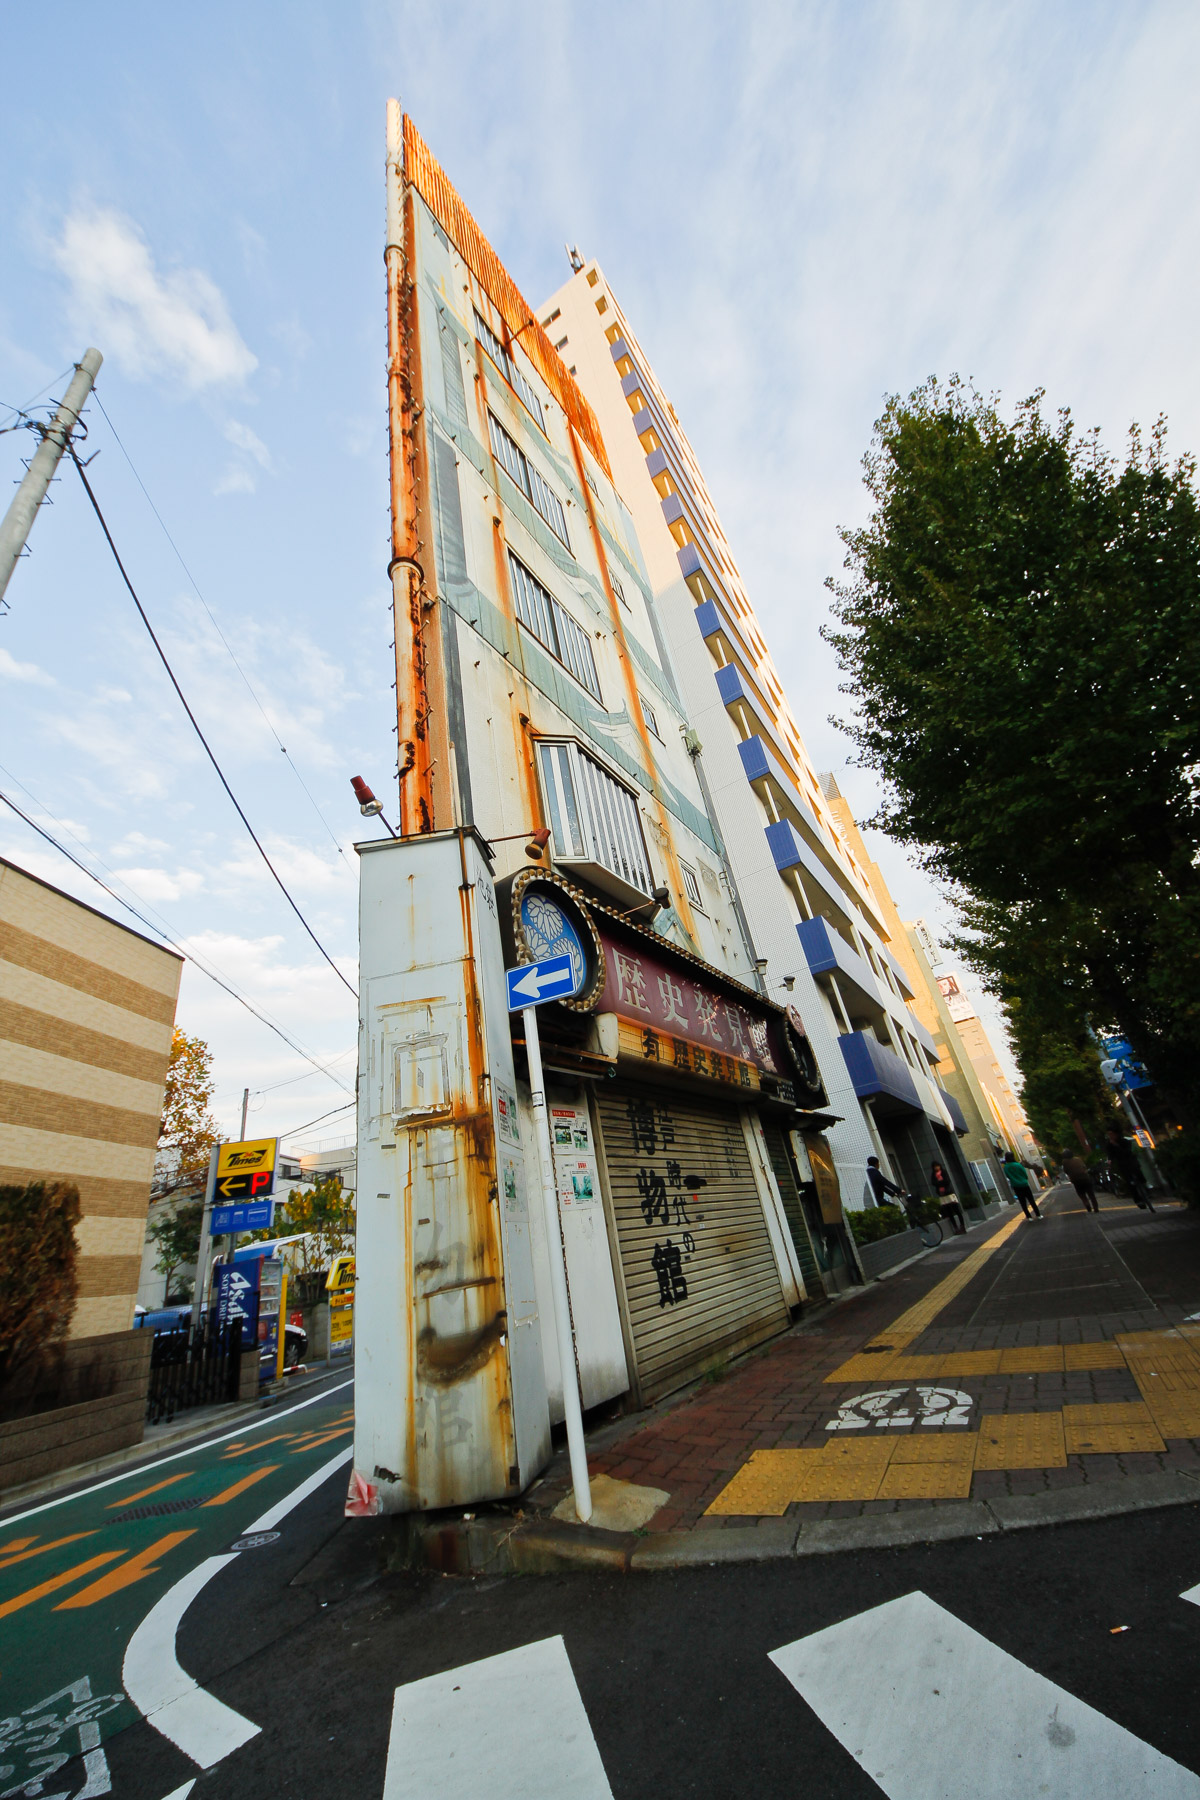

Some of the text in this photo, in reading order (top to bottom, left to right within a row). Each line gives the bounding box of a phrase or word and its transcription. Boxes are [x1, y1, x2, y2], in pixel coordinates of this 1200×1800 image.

[672, 1037, 751, 1087] 歴史発見館
[227, 1150, 267, 1167] Times
[251, 1172, 270, 1195] P
[221, 1273, 230, 1297] SOFT
